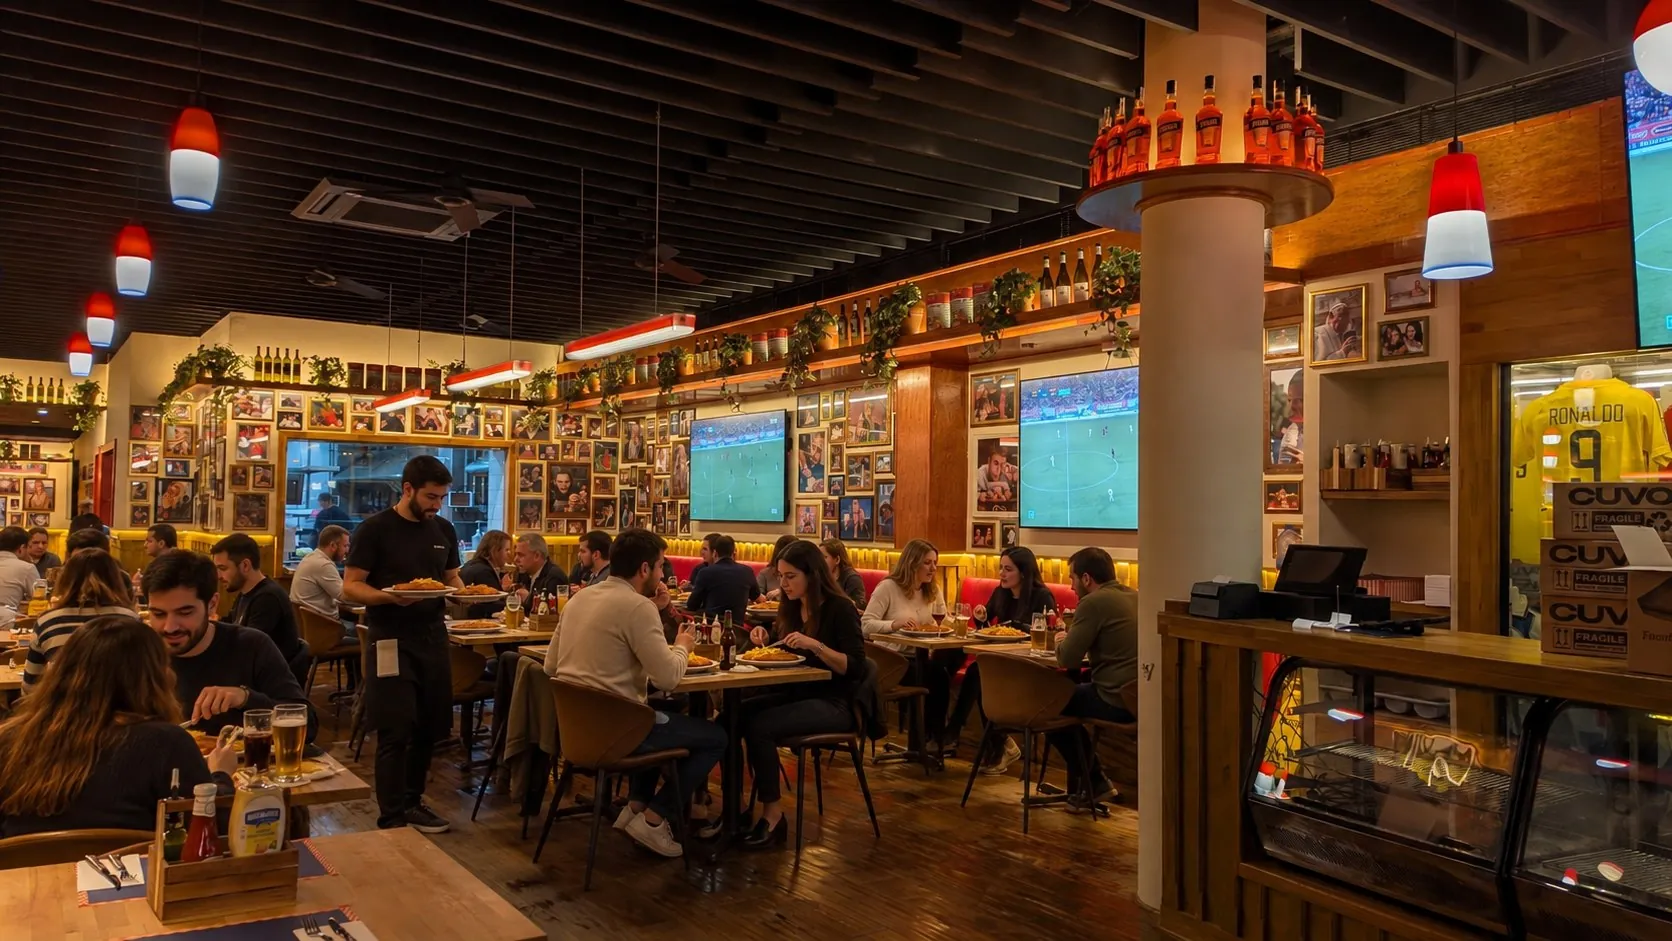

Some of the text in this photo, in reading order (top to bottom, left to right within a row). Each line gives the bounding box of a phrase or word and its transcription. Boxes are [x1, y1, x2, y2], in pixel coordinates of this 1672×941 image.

[1550, 404, 1623, 425] RONALDO
[1570, 429, 1601, 482] 9
[1595, 514, 1641, 524] FRAGILE
[1576, 573, 1625, 584] FRAGILE
[1576, 632, 1625, 644] FRAGILE
